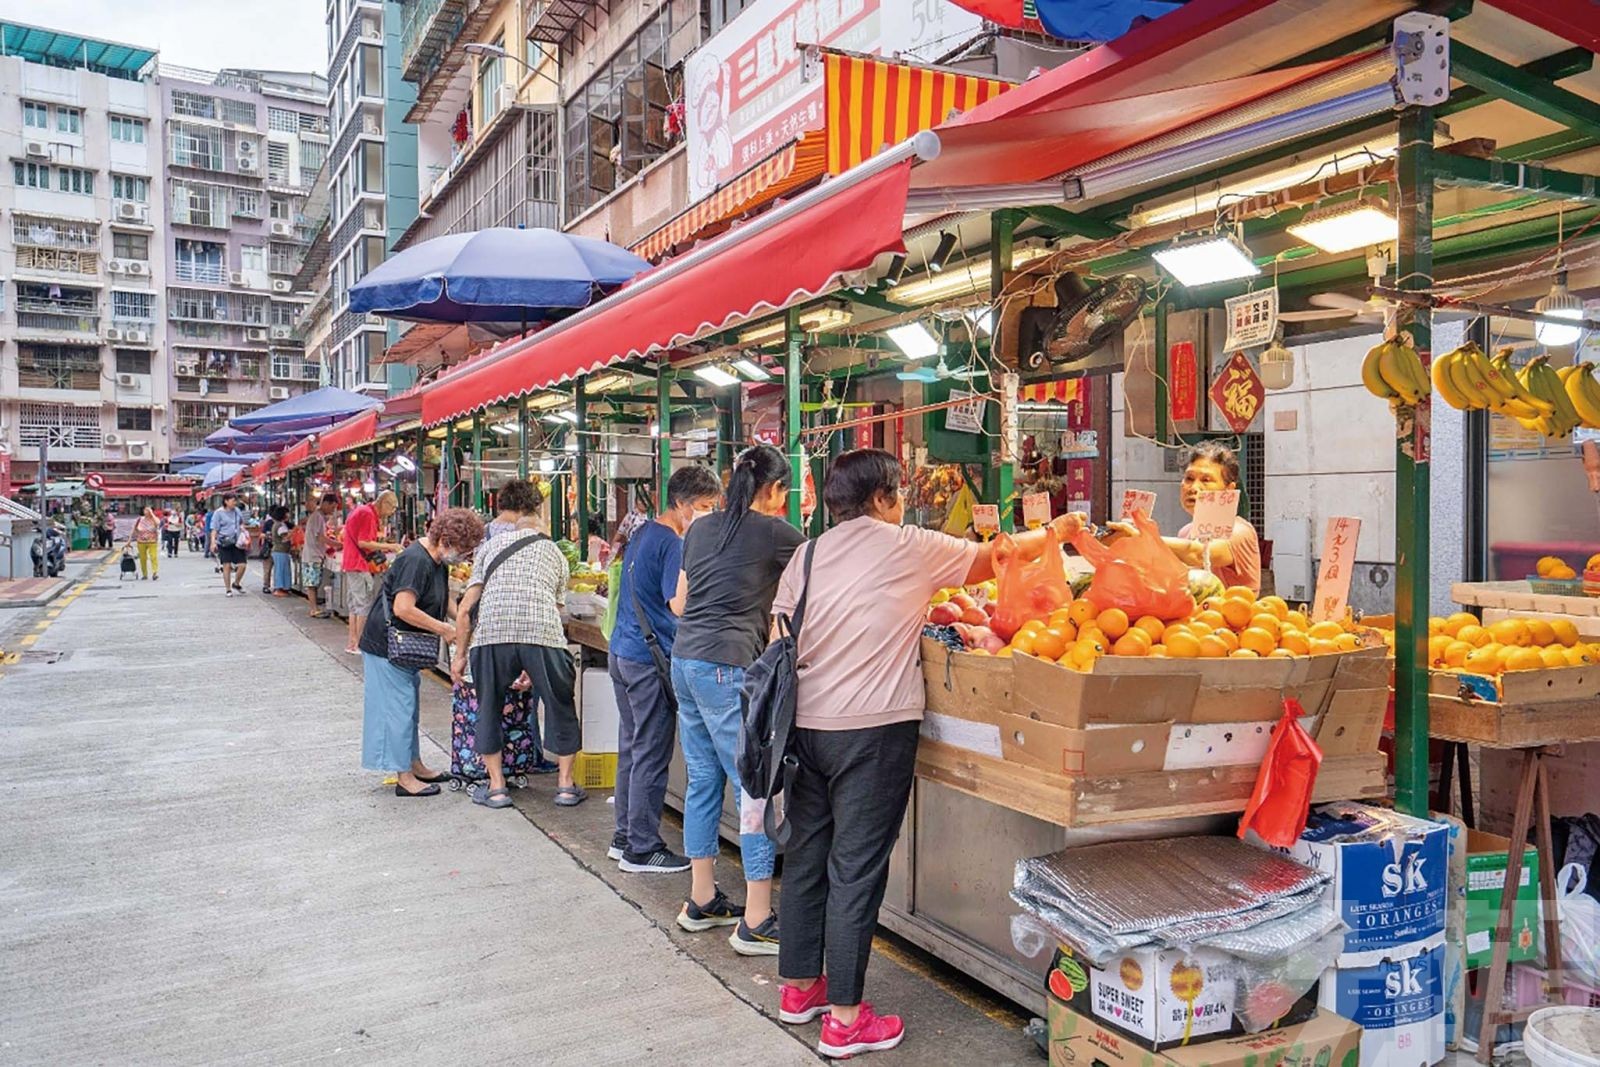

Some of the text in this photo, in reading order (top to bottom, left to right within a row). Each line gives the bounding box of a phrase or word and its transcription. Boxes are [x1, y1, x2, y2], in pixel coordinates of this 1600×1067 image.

[1223, 367, 1258, 421] 福
[1366, 900, 1437, 927] ORANGES
[1097, 982, 1144, 1014] SUPER SWEET
[1374, 999, 1430, 1017] ORANGES
